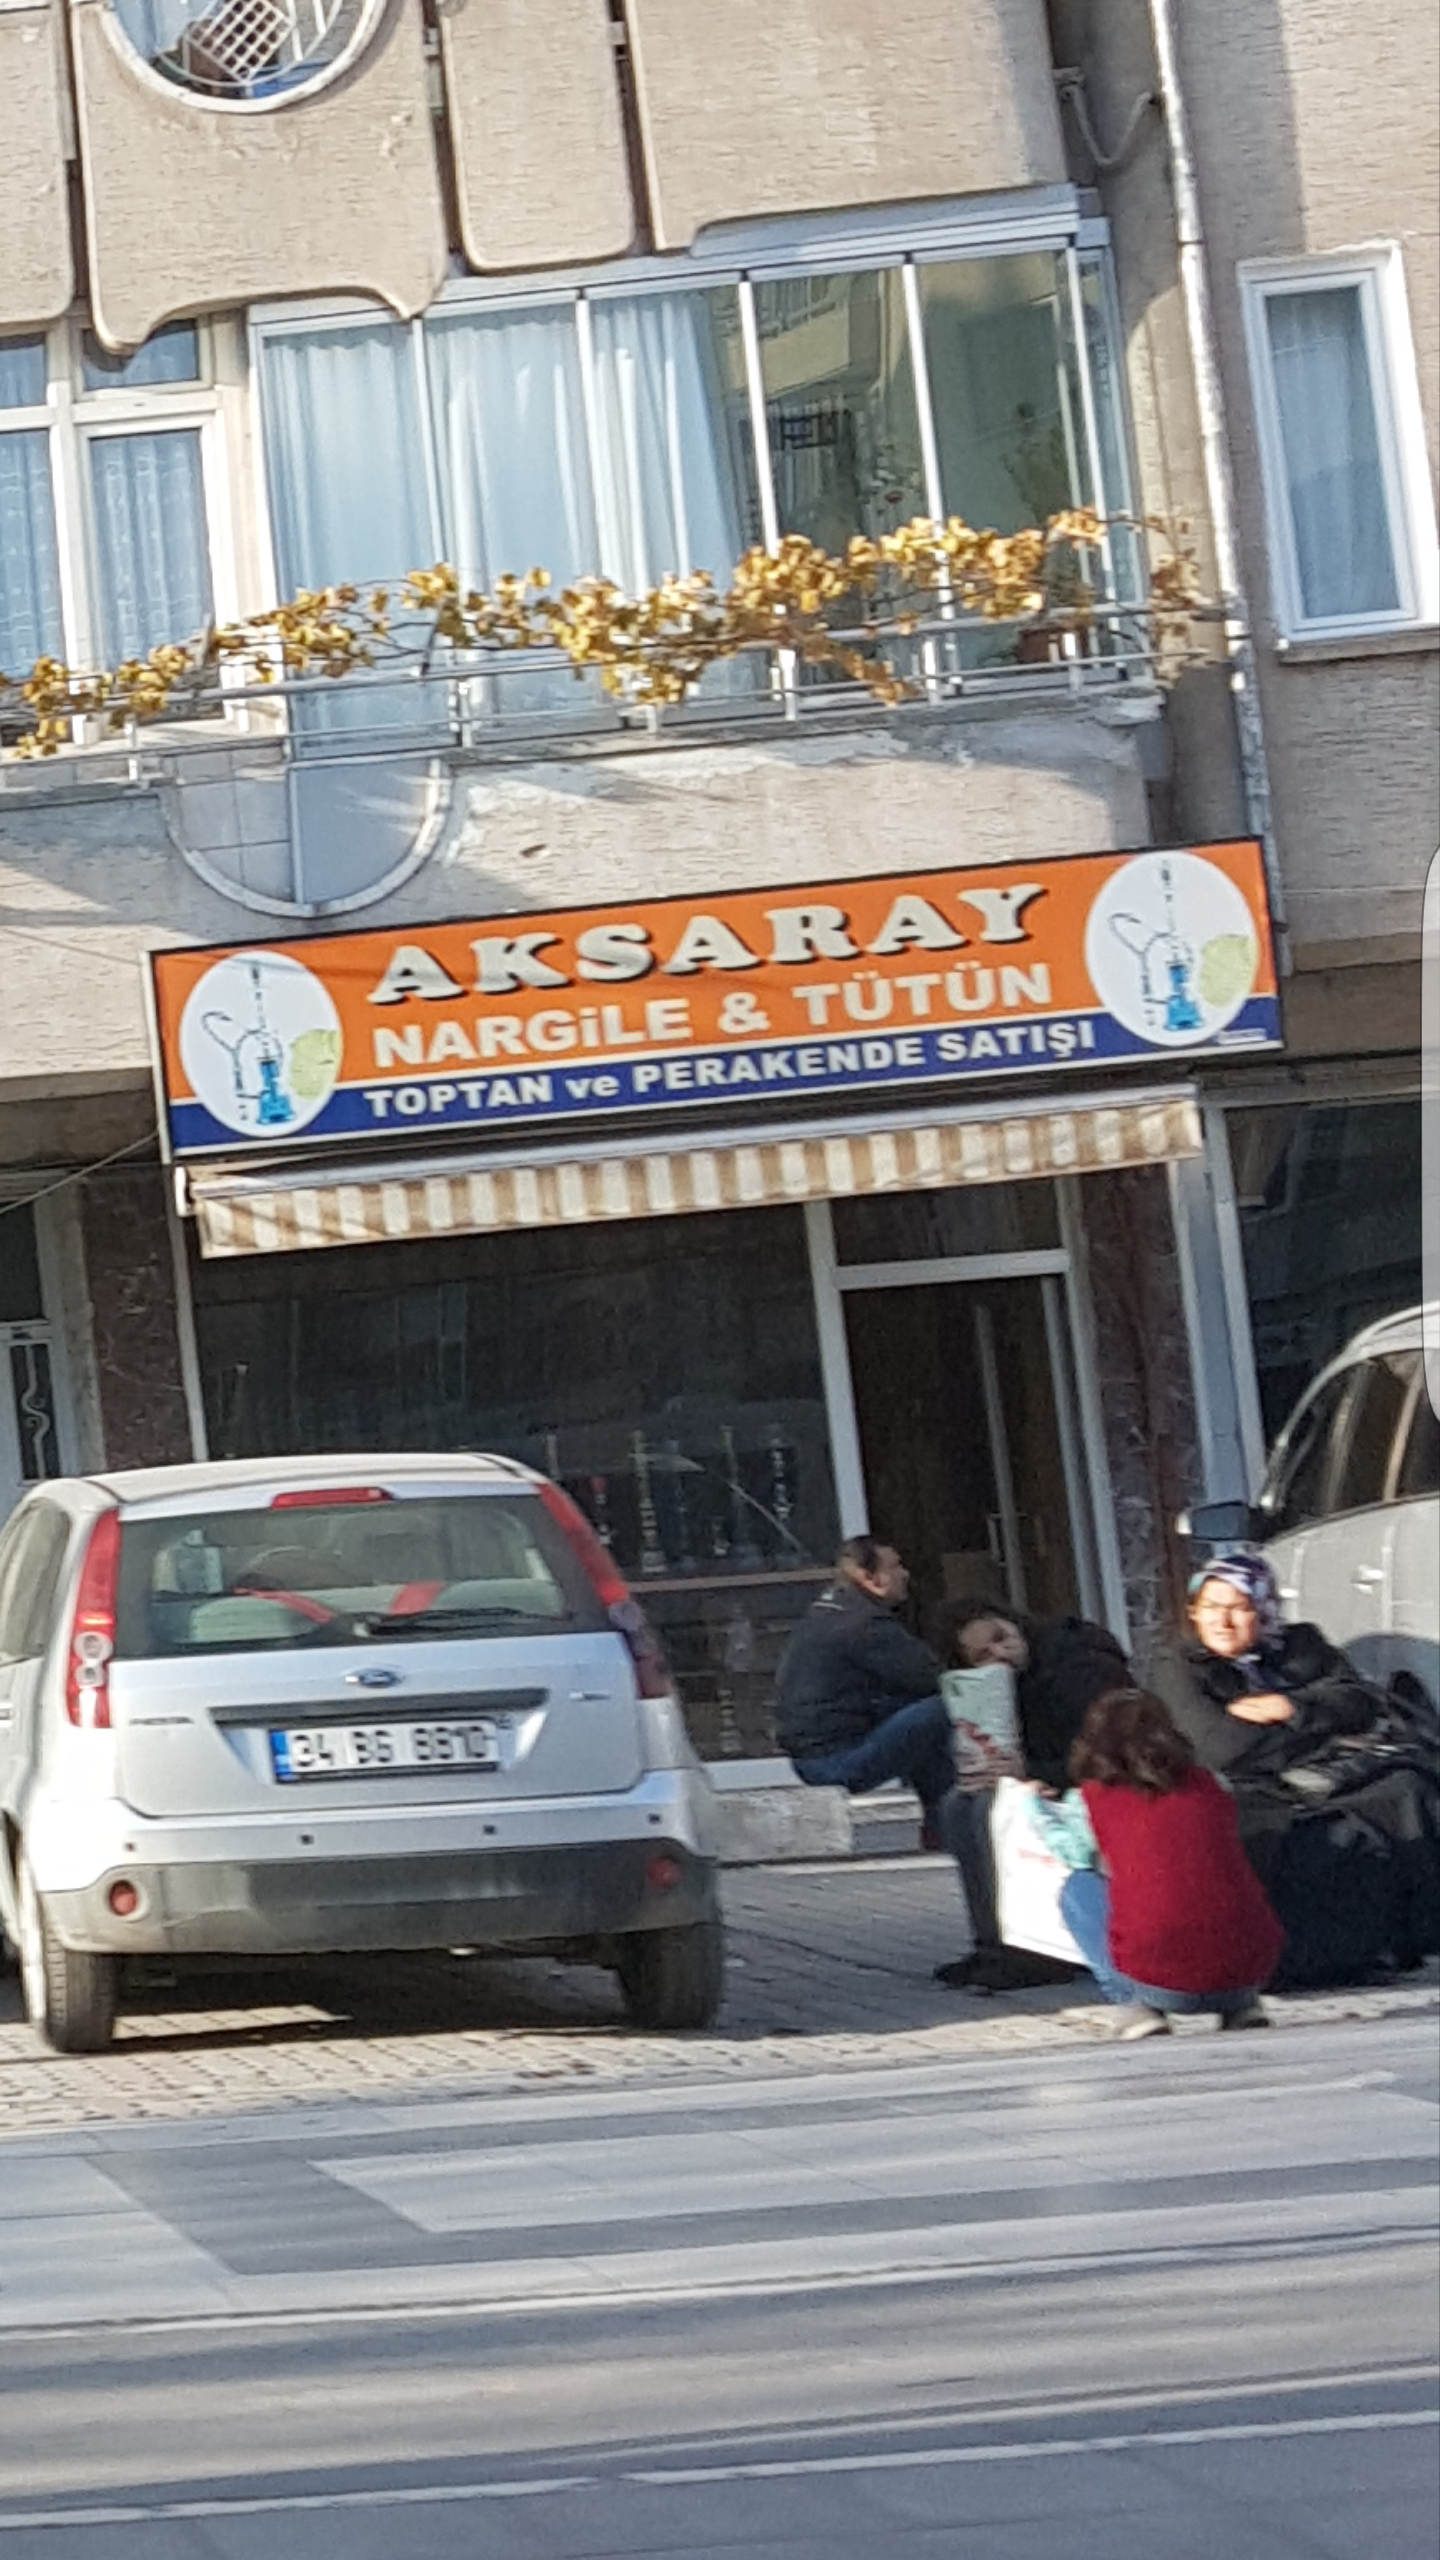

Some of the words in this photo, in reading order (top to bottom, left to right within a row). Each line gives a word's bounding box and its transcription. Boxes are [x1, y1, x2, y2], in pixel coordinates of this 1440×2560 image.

[367, 883, 1046, 1004] AKSARAY
[717, 991, 771, 1034] &
[792, 961, 1053, 1027] TÜTÜN
[365, 1074, 553, 1119] TOPTAN
[565, 1073, 620, 1099] ve
[633, 1035, 924, 1094] PERAKENDE
[936, 1020, 1096, 1060] SATIŞI
[293, 1733, 335, 1769] 34
